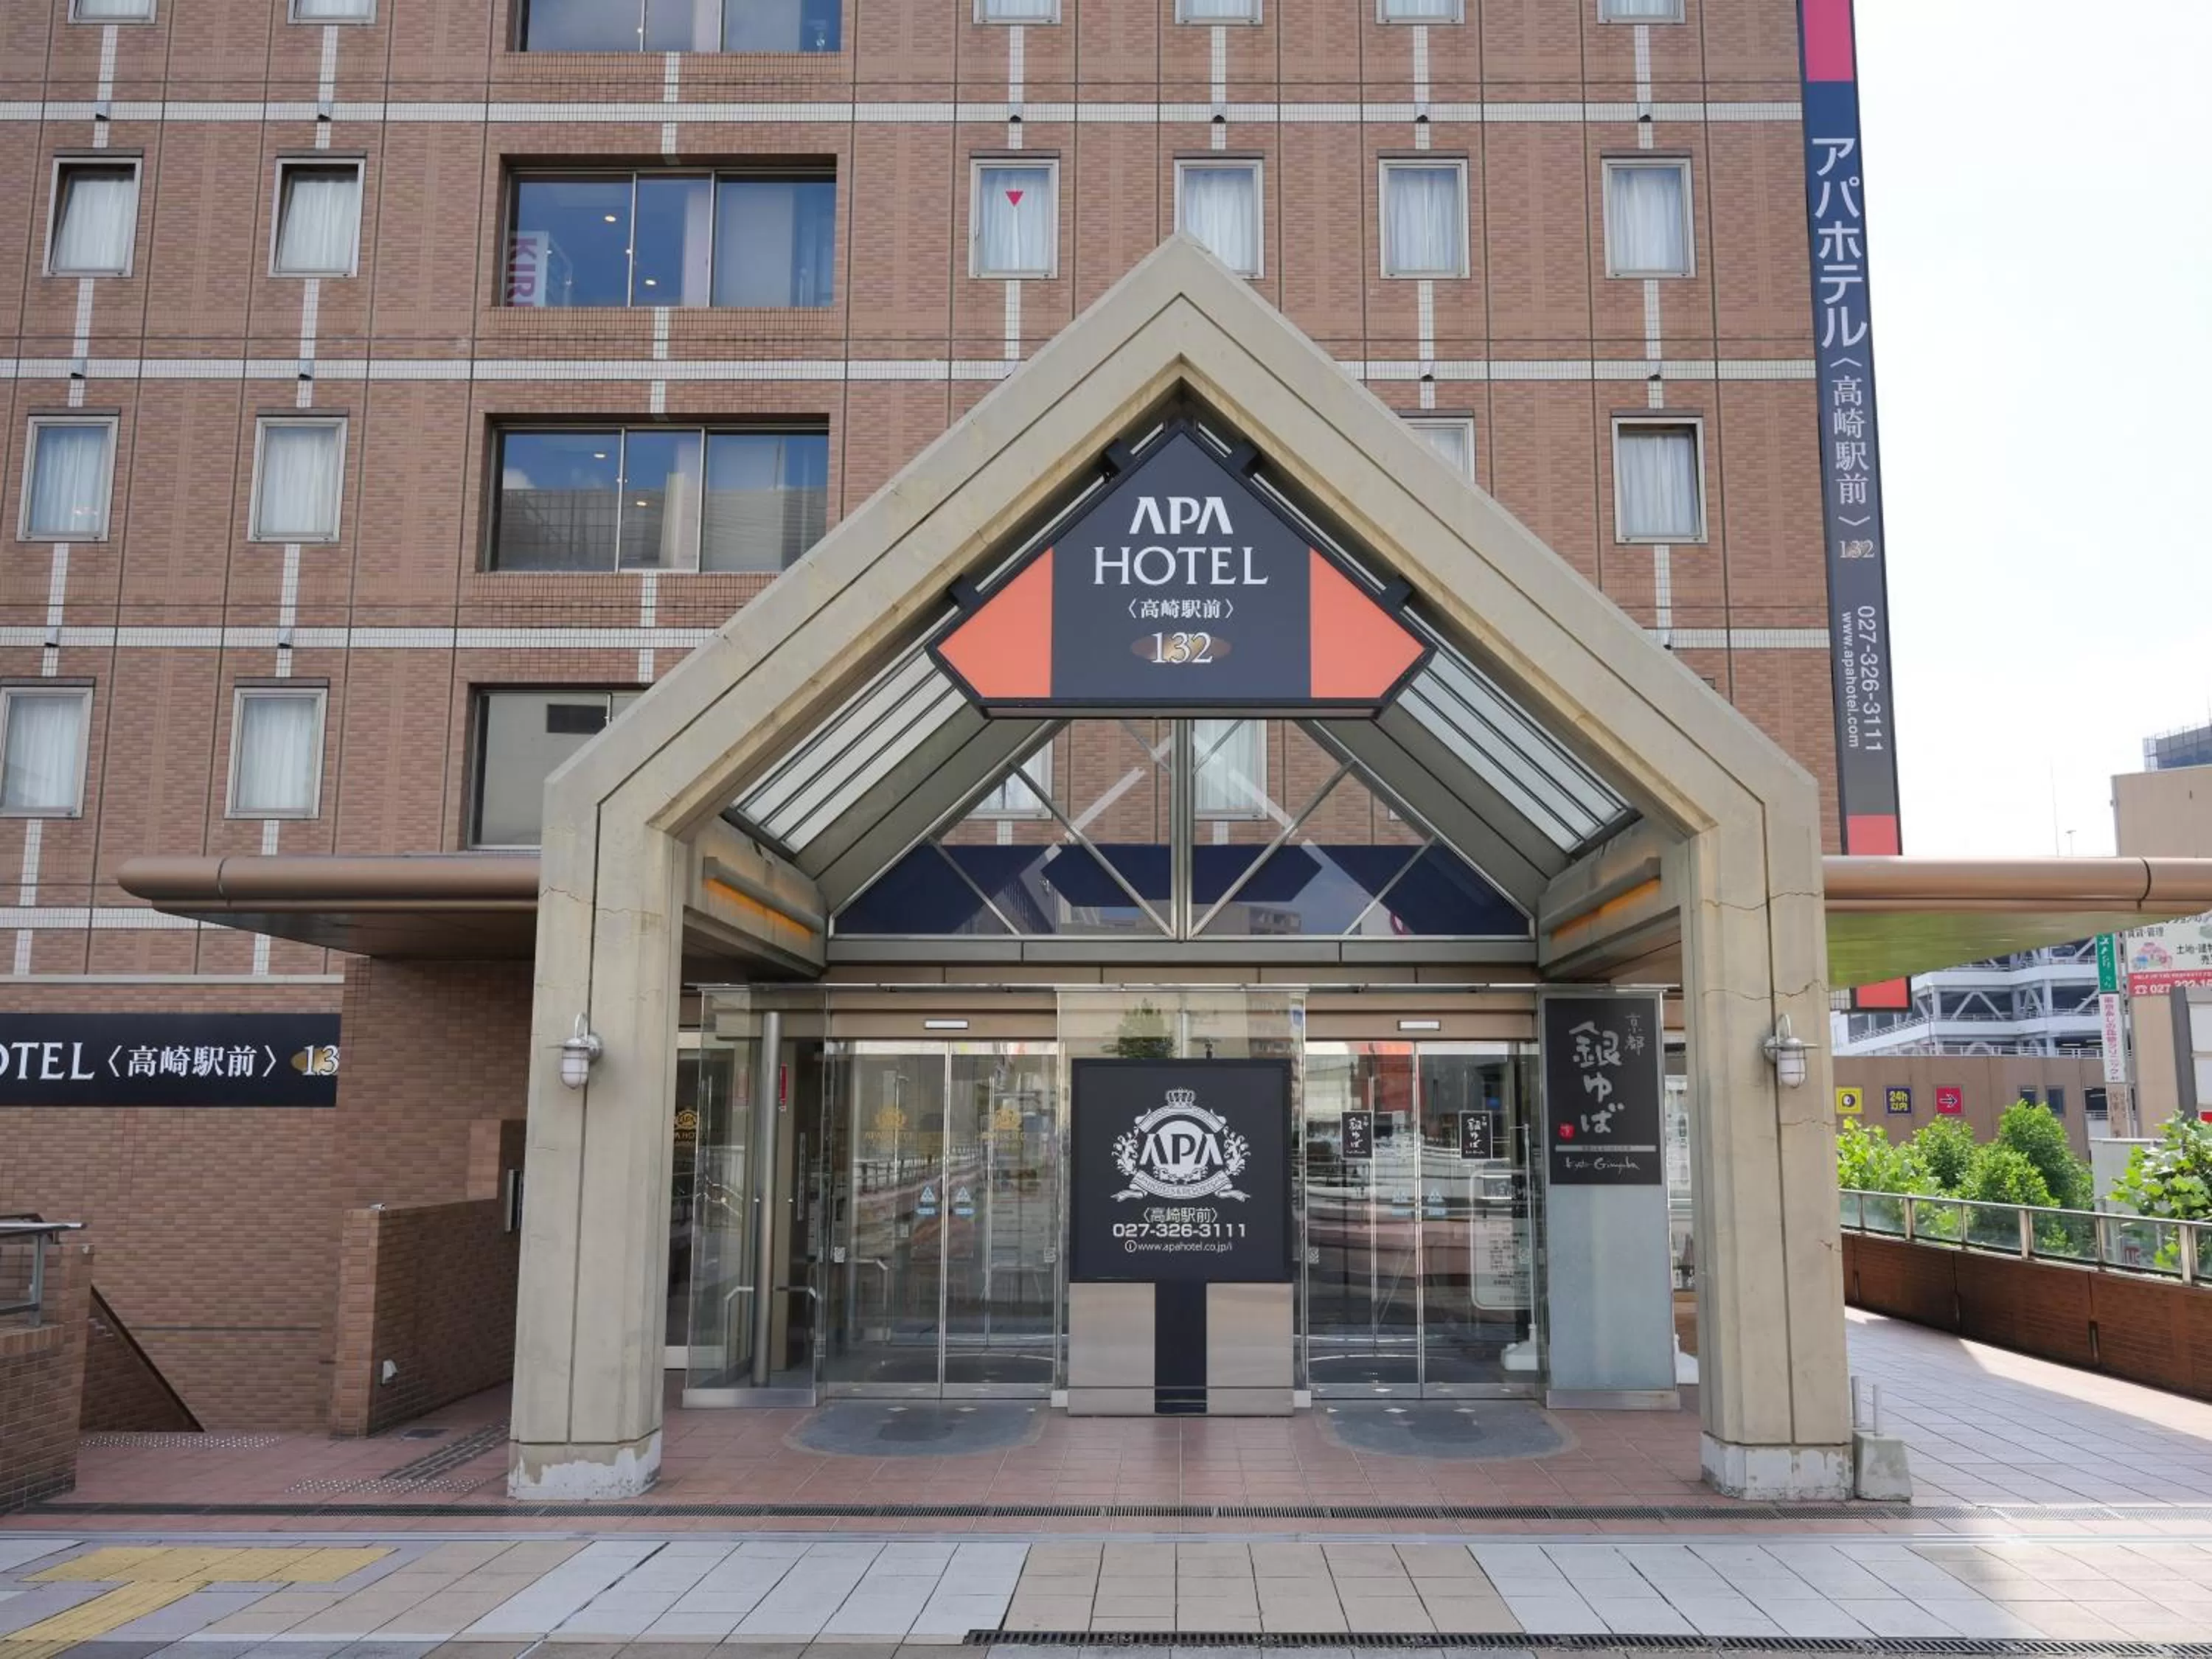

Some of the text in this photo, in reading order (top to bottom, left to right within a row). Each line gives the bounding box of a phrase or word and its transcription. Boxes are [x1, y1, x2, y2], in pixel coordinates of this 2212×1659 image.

[1812, 137, 1868, 349] アパホテル
[1129, 496, 1234, 535] APA
[1093, 546, 1269, 585] HOTEL
[1839, 539, 1875, 559] 132
[1150, 632, 1214, 664] 132
[1841, 612, 1859, 748] www.apahotel.com
[1857, 605, 1883, 751] 027-326-3111
[1624, 1012, 1646, 1056] 京都
[0, 1042, 95, 1081] TEL
[1568, 1020, 1625, 1134] 銀ゆば
[1139, 1133, 1224, 1165] APA
[1113, 1223, 1246, 1238] 027-326-3111
